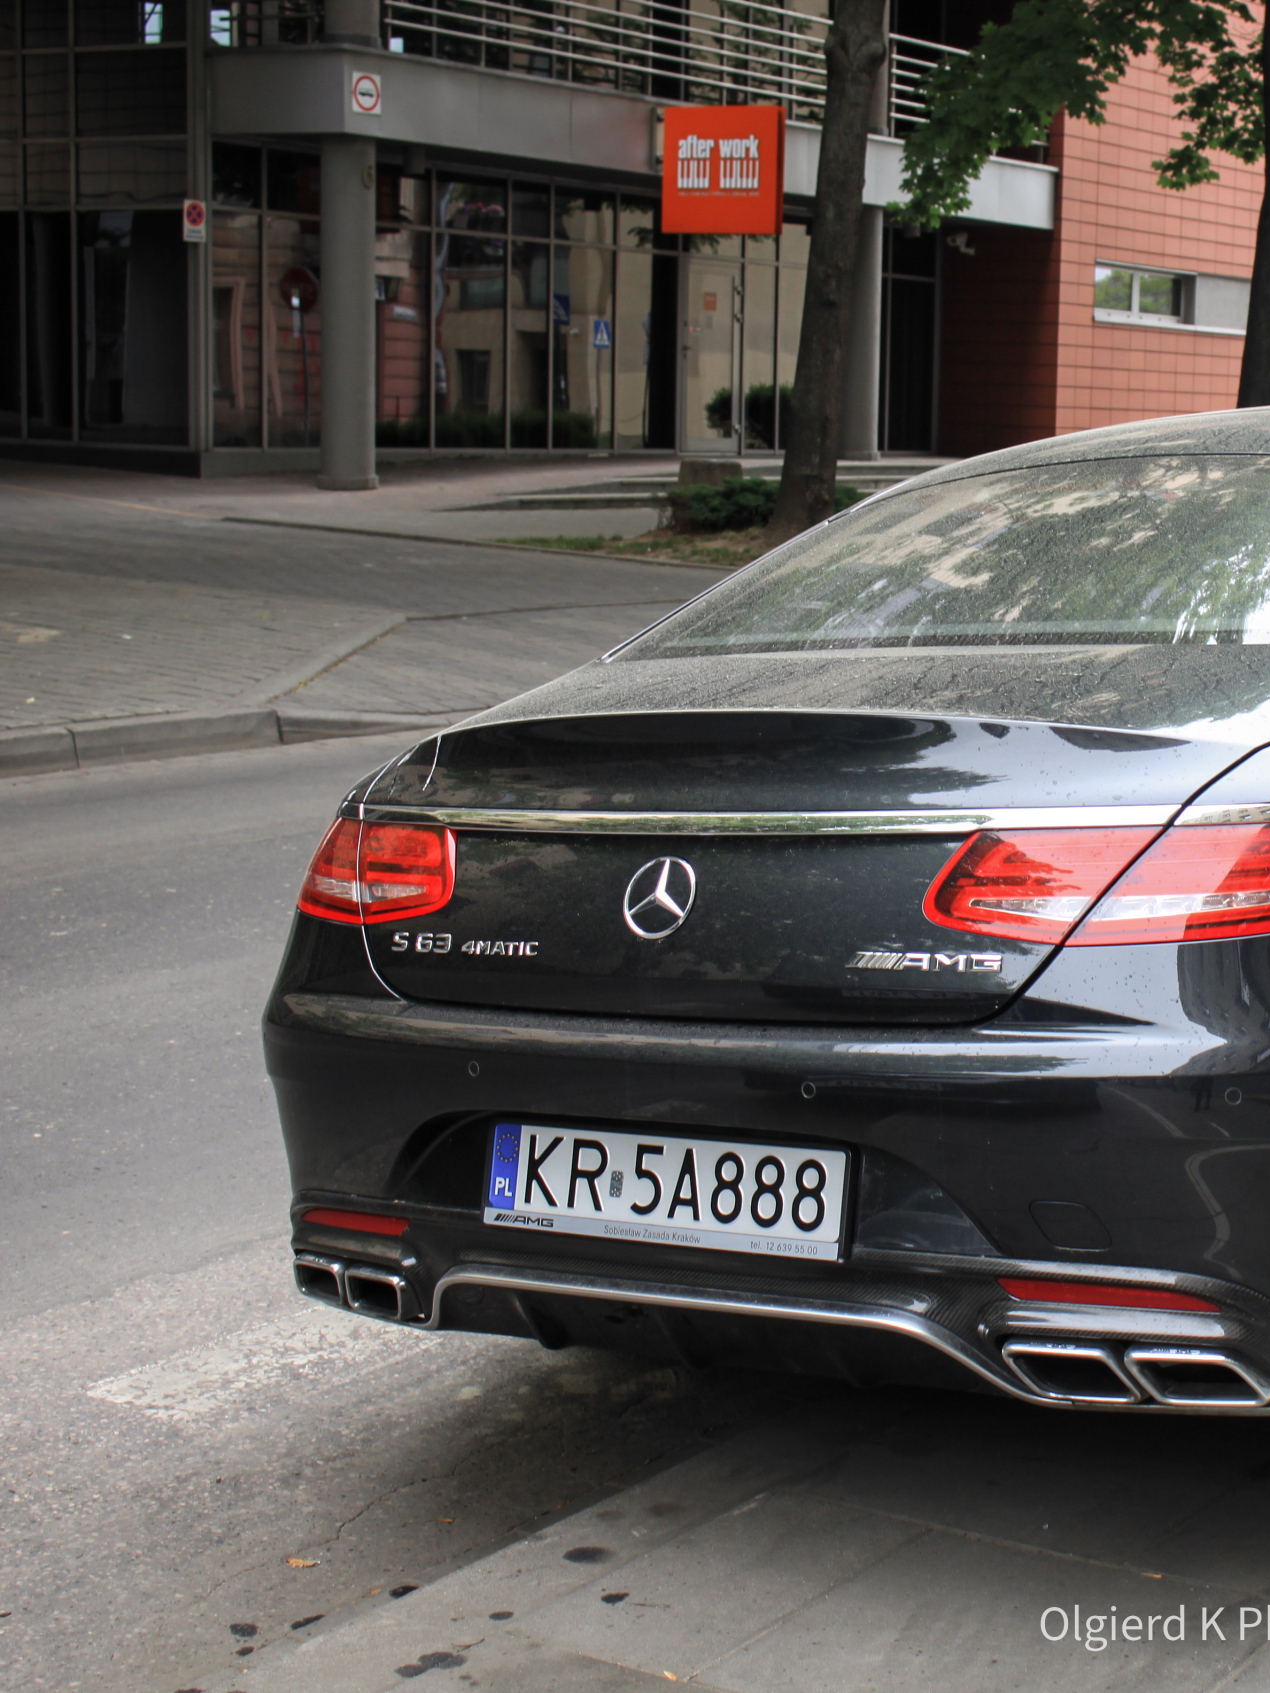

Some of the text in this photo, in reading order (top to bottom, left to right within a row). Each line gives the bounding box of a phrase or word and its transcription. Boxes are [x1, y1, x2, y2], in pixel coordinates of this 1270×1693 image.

[678, 134, 759, 159] after work
[391, 931, 539, 957] S 63 4MATIC
[902, 951, 1003, 973] AMG
[494, 1176, 513, 1198] PL
[512, 1215, 554, 1228] AMG
[604, 1224, 701, 1244] Sobiesław Zasada Kraków
[750, 1241, 818, 1255] tel. 12 639 55 00
